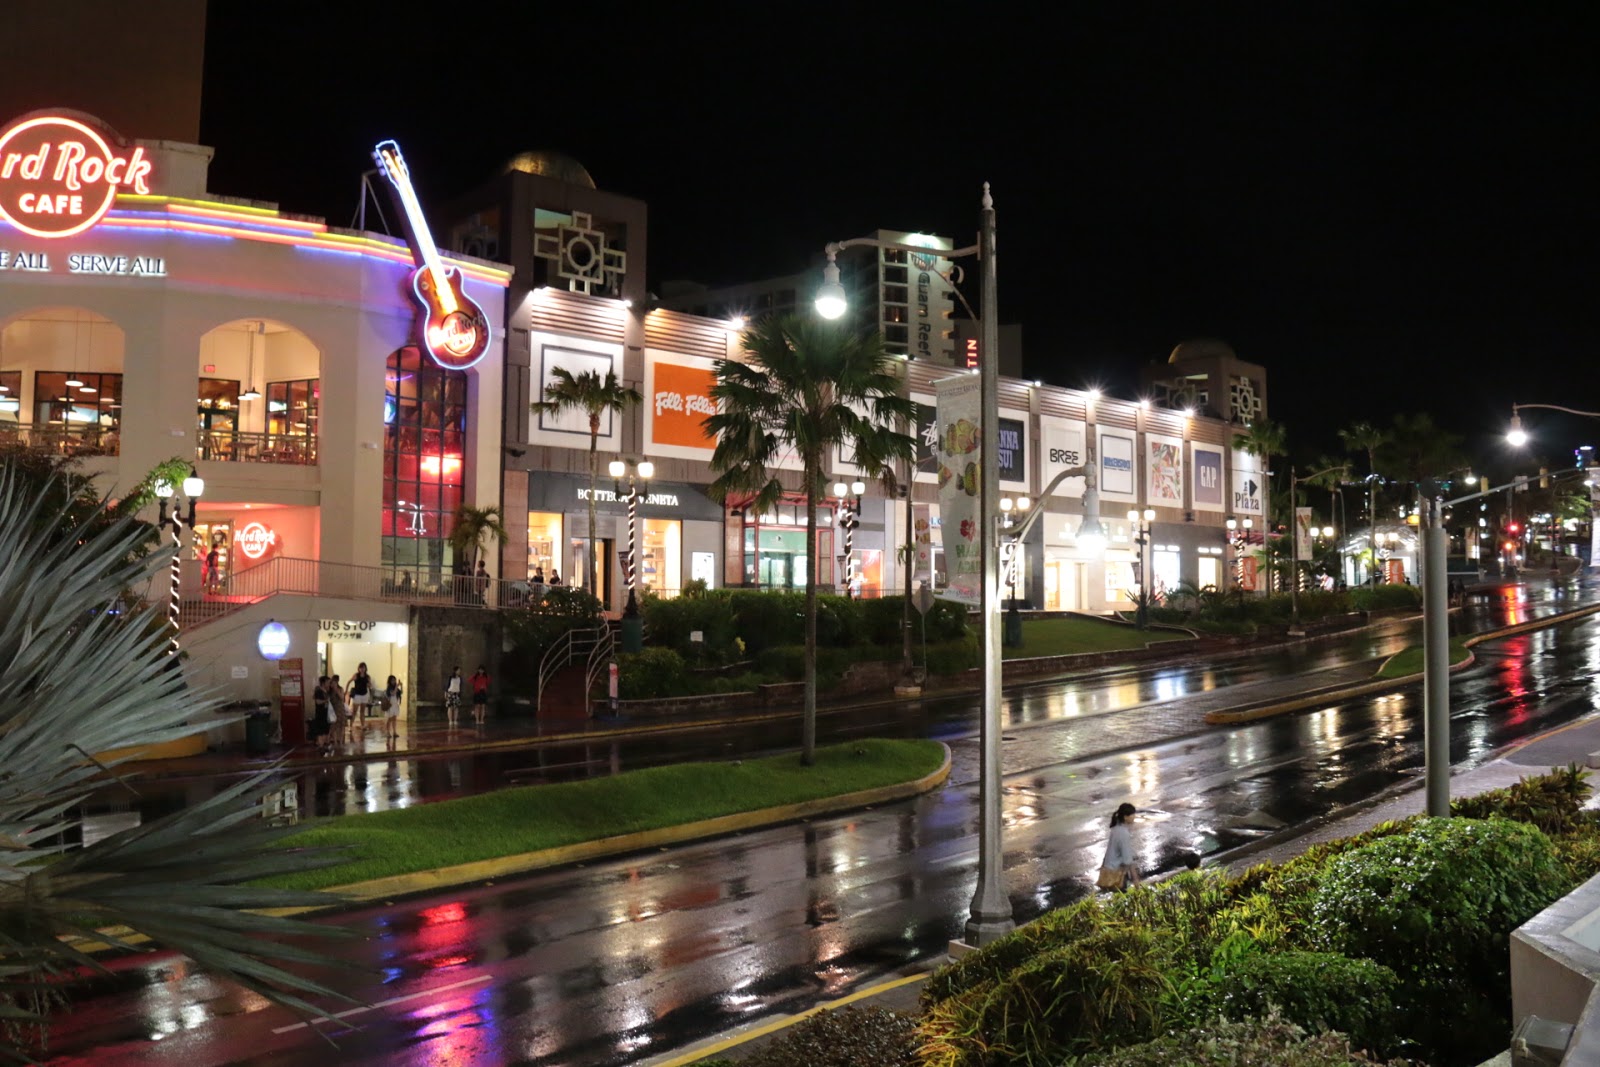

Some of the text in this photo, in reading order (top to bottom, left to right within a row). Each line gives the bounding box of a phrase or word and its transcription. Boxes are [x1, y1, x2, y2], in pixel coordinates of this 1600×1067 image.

[0, 142, 151, 195] rd Rock
[19, 193, 83, 215] CAFE
[13, 253, 50, 271] ALL
[69, 255, 127, 272] SERVE
[130, 257, 166, 275] ALL
[918, 272, 931, 356] Guam Reef
[656, 391, 716, 416] Folli Follie
[1201, 465, 1217, 489] GAP
[1234, 492, 1260, 511] Plaza
